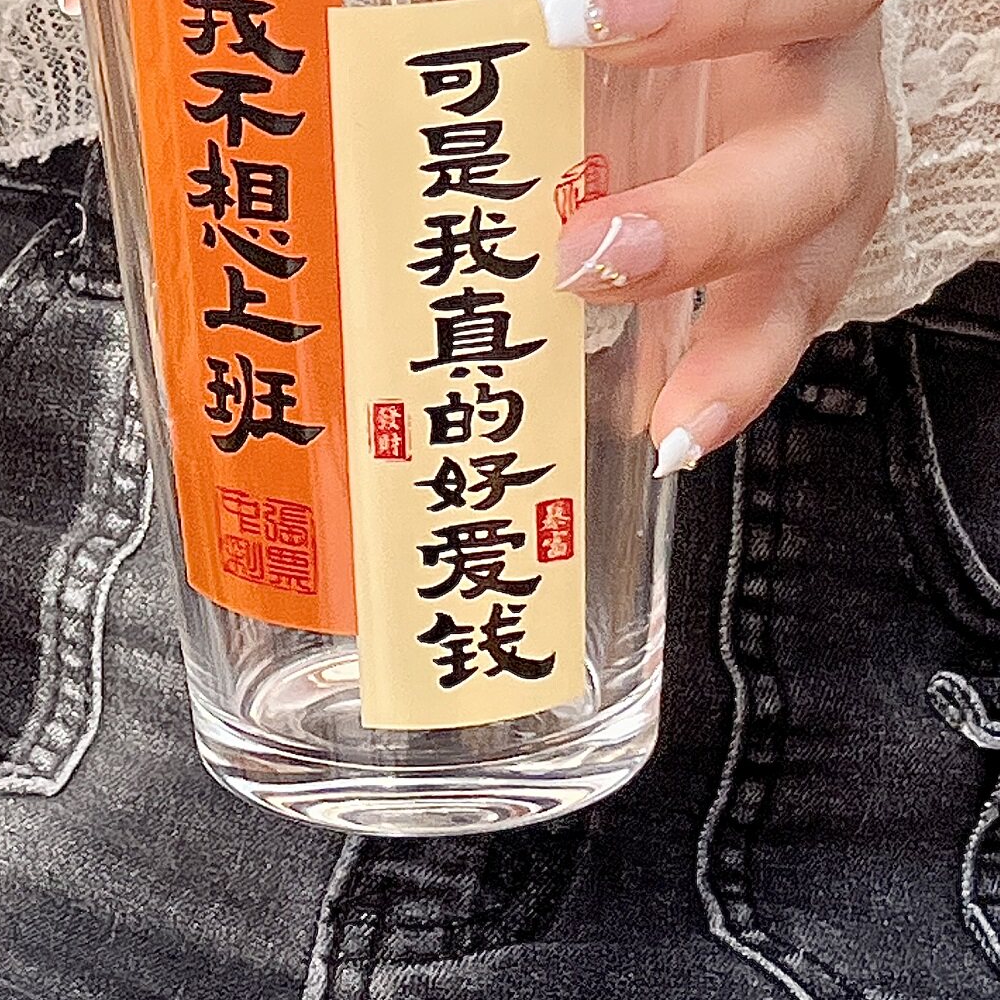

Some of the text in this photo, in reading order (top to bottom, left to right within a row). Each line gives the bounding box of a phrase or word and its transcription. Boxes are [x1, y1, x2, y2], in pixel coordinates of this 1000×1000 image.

[405, 41, 558, 690] 可是我真的好爱钱
